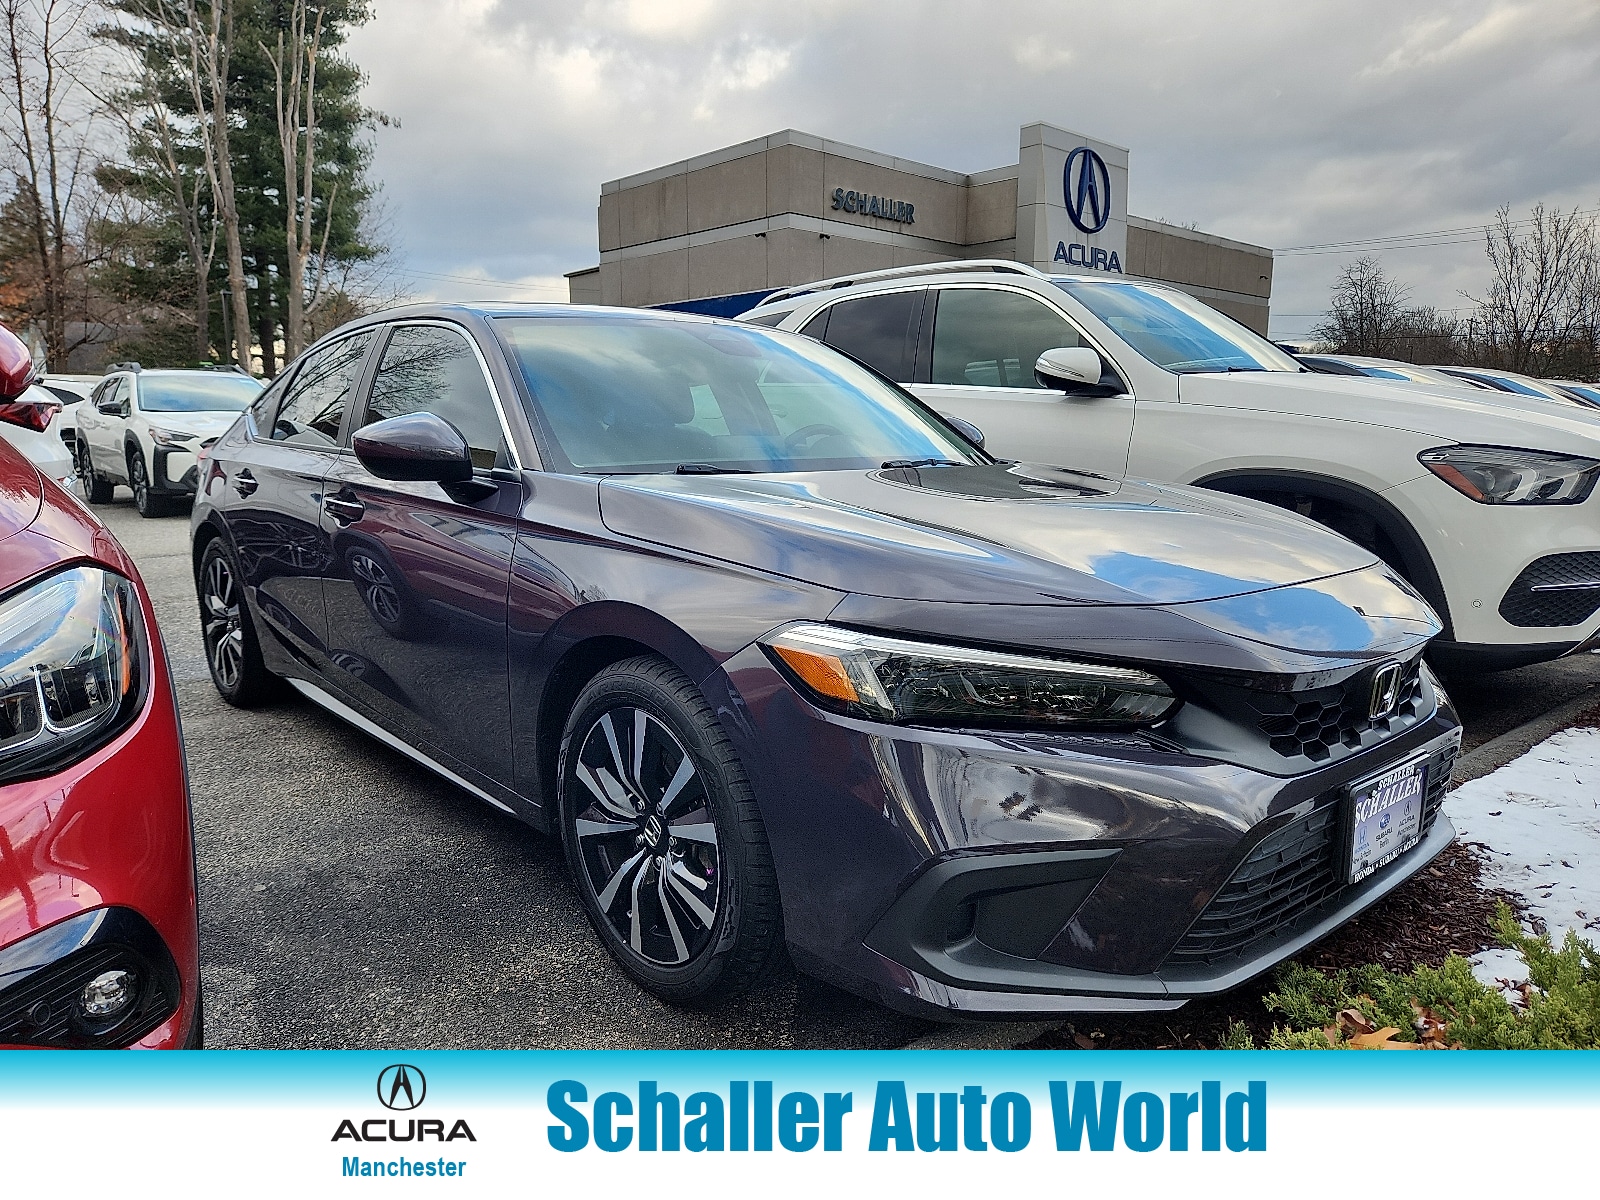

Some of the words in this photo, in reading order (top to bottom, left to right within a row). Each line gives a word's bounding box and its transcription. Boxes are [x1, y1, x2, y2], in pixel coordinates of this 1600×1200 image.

[831, 187, 916, 225] SCHALLER
[1053, 240, 1123, 274] ACURA
[1377, 764, 1415, 790] SCHALLER
[1355, 773, 1422, 827] SCHALLER
[1375, 827, 1393, 842] SUBARU
[1398, 814, 1415, 827] ACURA
[1354, 864, 1375, 884] HONDA
[1379, 848, 1401, 868] SUBARU
[1402, 837, 1419, 854] ACURA
